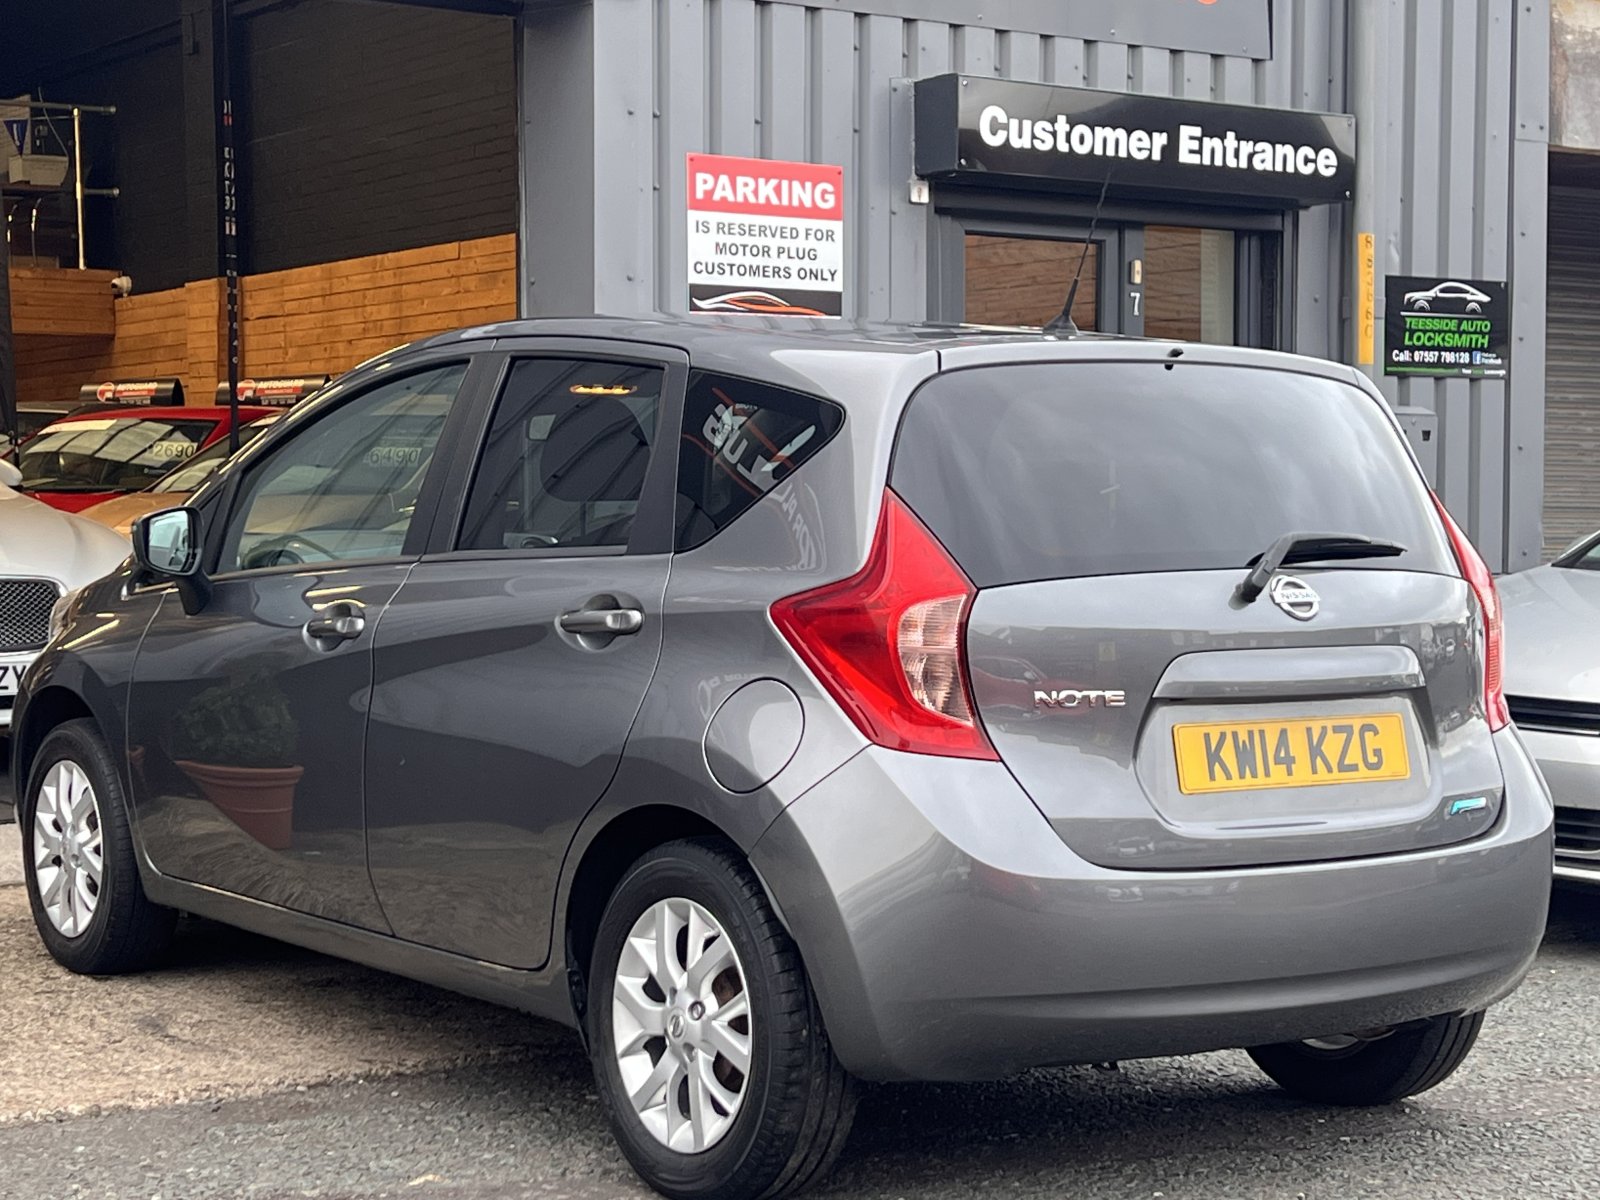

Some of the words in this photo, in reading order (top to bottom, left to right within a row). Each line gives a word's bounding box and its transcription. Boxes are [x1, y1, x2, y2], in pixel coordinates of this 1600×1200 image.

[979, 105, 1168, 161] Customer
[1178, 124, 1339, 178] Entrance
[694, 172, 836, 209] PARKING
[695, 220, 711, 234] IS
[716, 222, 799, 240] RESERVED
[805, 228, 836, 243] FOR
[715, 242, 772, 259] MOTOR
[777, 246, 818, 261] PLUG
[693, 261, 792, 279] CUSTOMERS
[797, 267, 838, 282] ONLY
[1130, 292, 1141, 316] 7
[1405, 317, 1459, 330] TEESSIDE
[1460, 320, 1491, 333] AUTO
[1404, 331, 1489, 349] LOCKSMITH
[1392, 350, 1412, 362] Call:
[1413, 350, 1439, 363] 07557
[154, 443, 195, 458] 2690
[1033, 690, 1126, 707] NOTE
[1203, 728, 1296, 782] KW14
[1305, 723, 1384, 775] KZG
